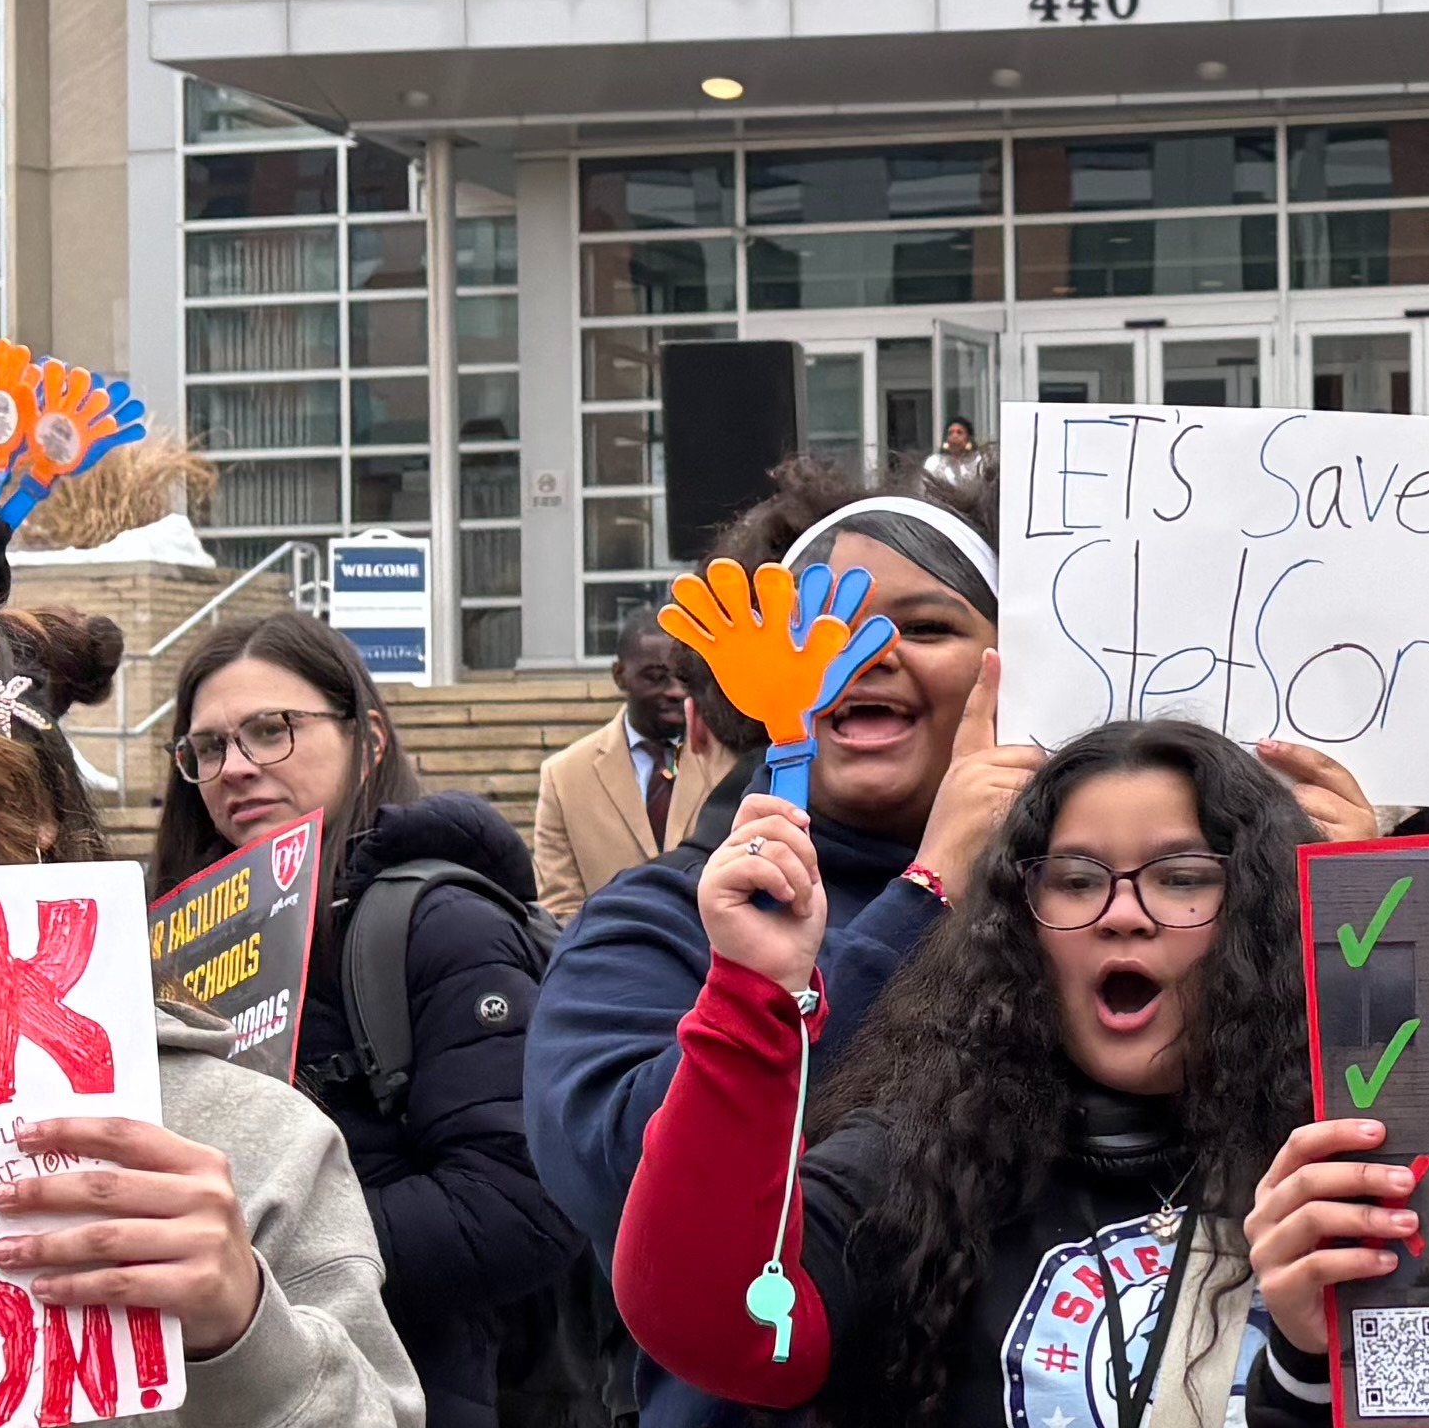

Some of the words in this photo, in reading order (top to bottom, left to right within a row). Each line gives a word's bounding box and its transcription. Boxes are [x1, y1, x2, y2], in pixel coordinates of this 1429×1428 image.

[1025, 410, 1204, 540] LET'S
[340, 563, 420, 578] WELCOME
[168, 867, 251, 954] FACILITIES
[183, 932, 261, 1002] SCHOOLS
